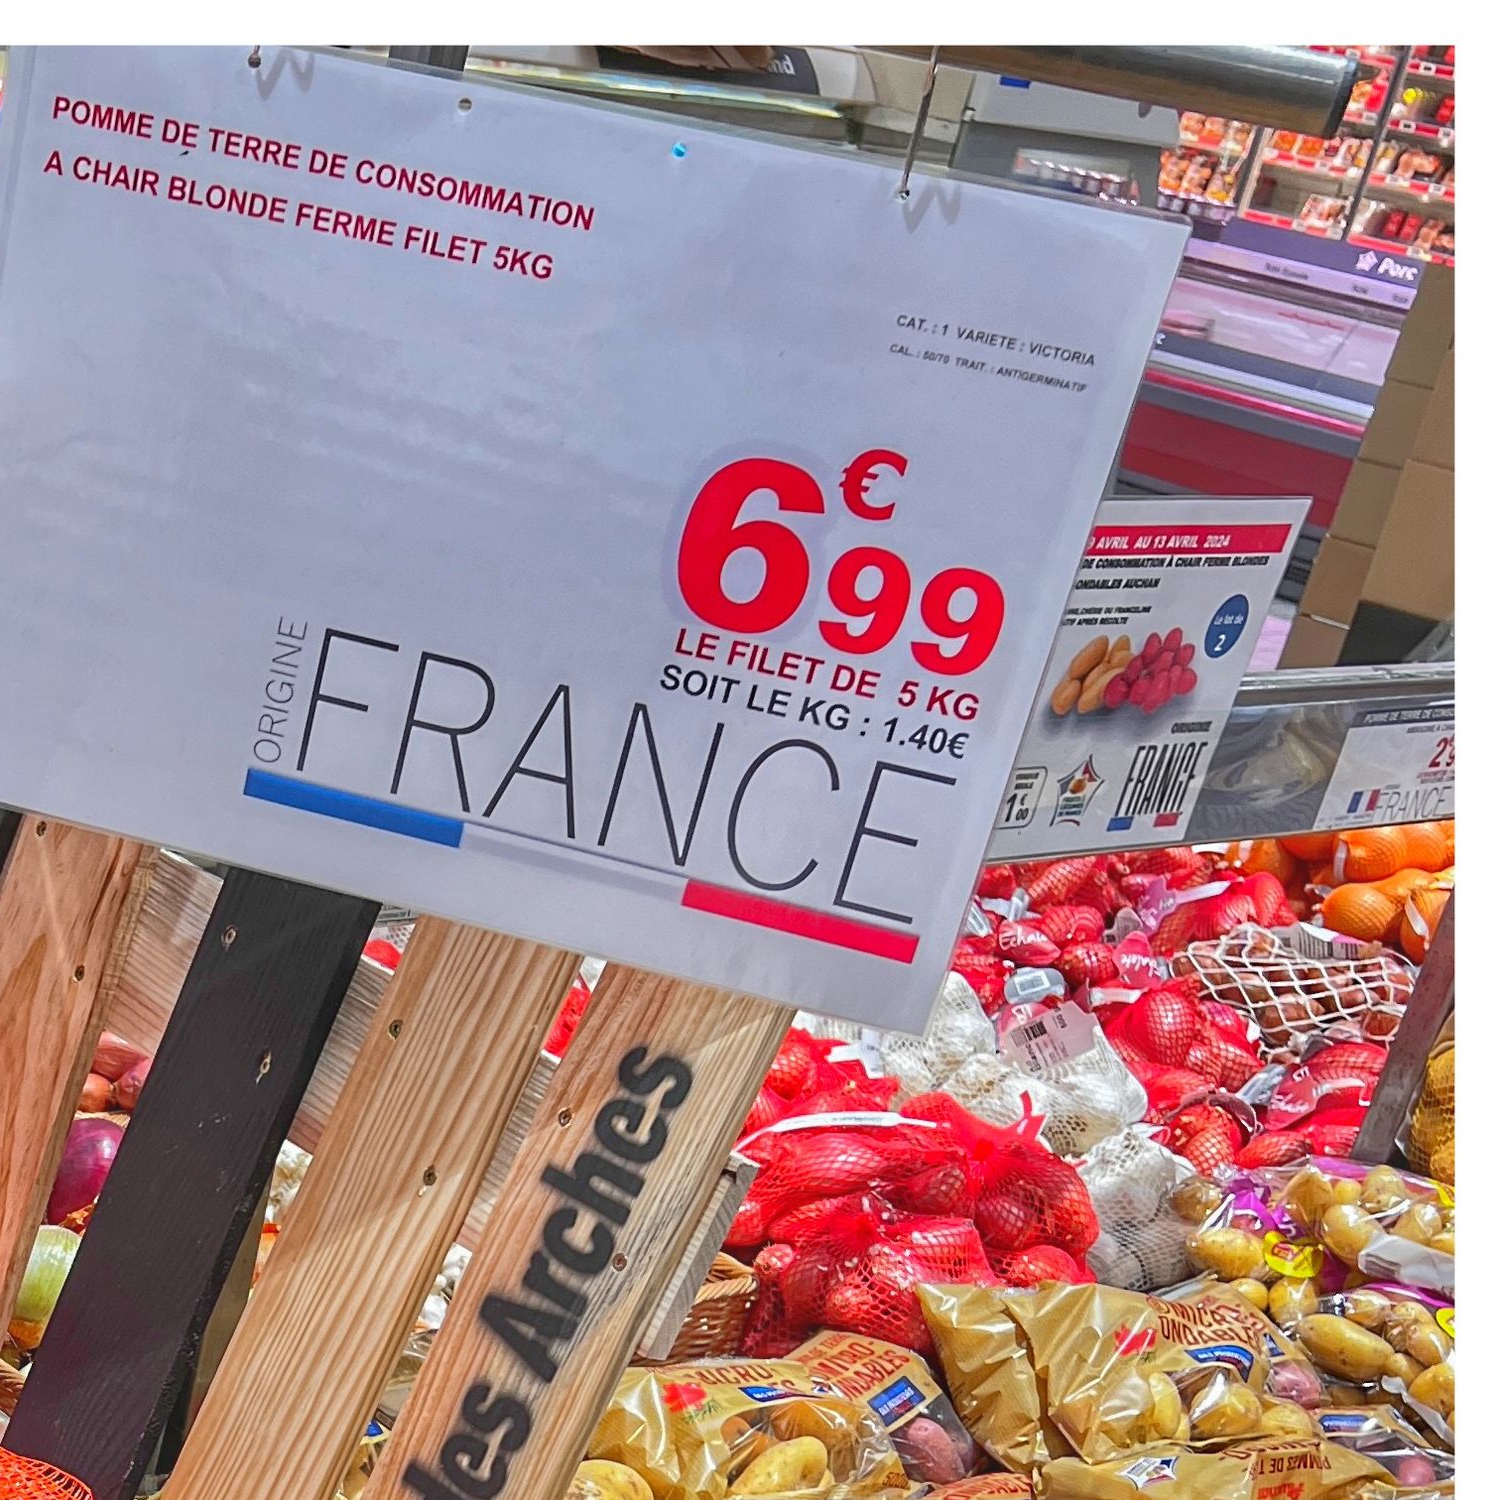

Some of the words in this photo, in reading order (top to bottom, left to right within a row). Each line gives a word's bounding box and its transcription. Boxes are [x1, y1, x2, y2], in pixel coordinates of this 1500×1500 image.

[52, 97, 154, 139] POMME
[161, 117, 199, 149] DE
[208, 129, 301, 170] TERRE
[309, 149, 348, 178] DE
[355, 158, 595, 231] CONSOMMATION
[43, 150, 64, 175] A
[73, 154, 160, 197] CHAIR
[167, 176, 288, 223] BLONDE
[295, 202, 397, 247] FERME
[403, 225, 488, 265] FILET
[493, 246, 554, 281] 5KG
[1378, 257, 1418, 281] Porc
[897, 315, 927, 332] CAT.
[957, 326, 1017, 350] VARIETE
[1029, 342, 1095, 367] VICTORIA
[997, 367, 1088, 392] ANTIGERMINATIF
[677, 457, 825, 634] 6
[818, 546, 1004, 676] 99
[1096, 557, 1165, 569] CONSOMMATION
[1175, 557, 1201, 568] CHAIR
[1232, 556, 1270, 566] BLONDES
[1097, 536, 1129, 549] AVRIL
[1134, 536, 1150, 549] AU
[1153, 536, 1166, 548] 13
[1167, 535, 1199, 548] AVRIL
[1203, 535, 1230, 548] 2024
[1123, 578, 1160, 589] AUCHAN
[675, 628, 717, 662] LE
[727, 640, 825, 686] FILET
[831, 665, 881, 698] DE
[898, 680, 920, 709] 5
[926, 687, 980, 721] KG
[1214, 634, 1226, 651] 2
[252, 616, 308, 765] ORIGINE
[660, 663, 741, 702] SOIT
[746, 686, 792, 718] LE
[799, 697, 852, 735] KG
[883, 715, 970, 760] 1.40€
[296, 627, 957, 924] FRANCE
[1115, 741, 1209, 818] FRANCE
[1372, 786, 1452, 822] FRANCE
[477, 1045, 694, 1385] Arches
